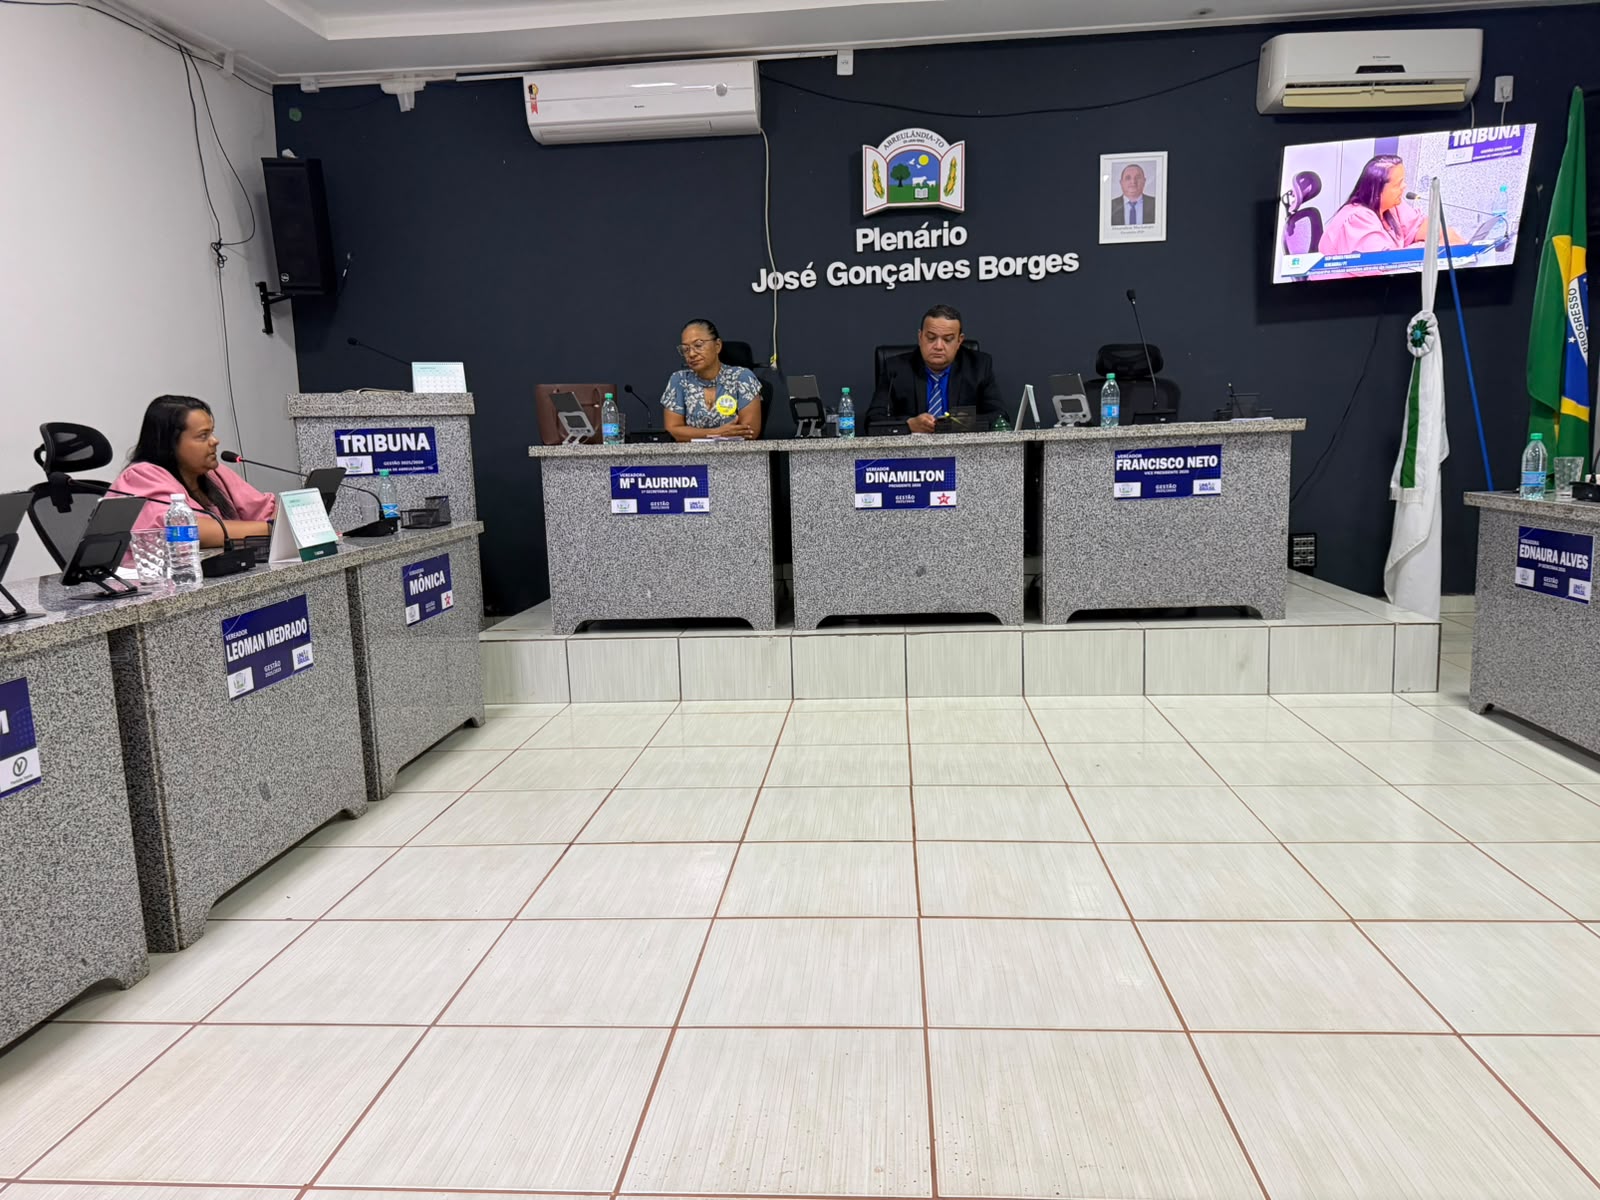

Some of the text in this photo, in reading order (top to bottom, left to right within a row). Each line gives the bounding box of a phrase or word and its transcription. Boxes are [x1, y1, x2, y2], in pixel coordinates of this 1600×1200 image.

[1452, 125, 1521, 147] TRIBUNA
[856, 221, 968, 253] Plenário
[751, 252, 1080, 293] José Gonçalves Borges
[1567, 287, 1589, 354] PROGRESSO
[339, 432, 431, 454] TRIBUNA
[1116, 455, 1219, 471] FRANCISCO NETO
[619, 476, 698, 489] Mª LAURINDA
[865, 470, 945, 484] DINAMILTON
[1519, 543, 1589, 570] EDNAURA ALVES
[409, 570, 446, 596] MÔNICA
[225, 628, 248, 641] VEREADOR
[226, 617, 308, 663] LEOMAN MEDRADO
